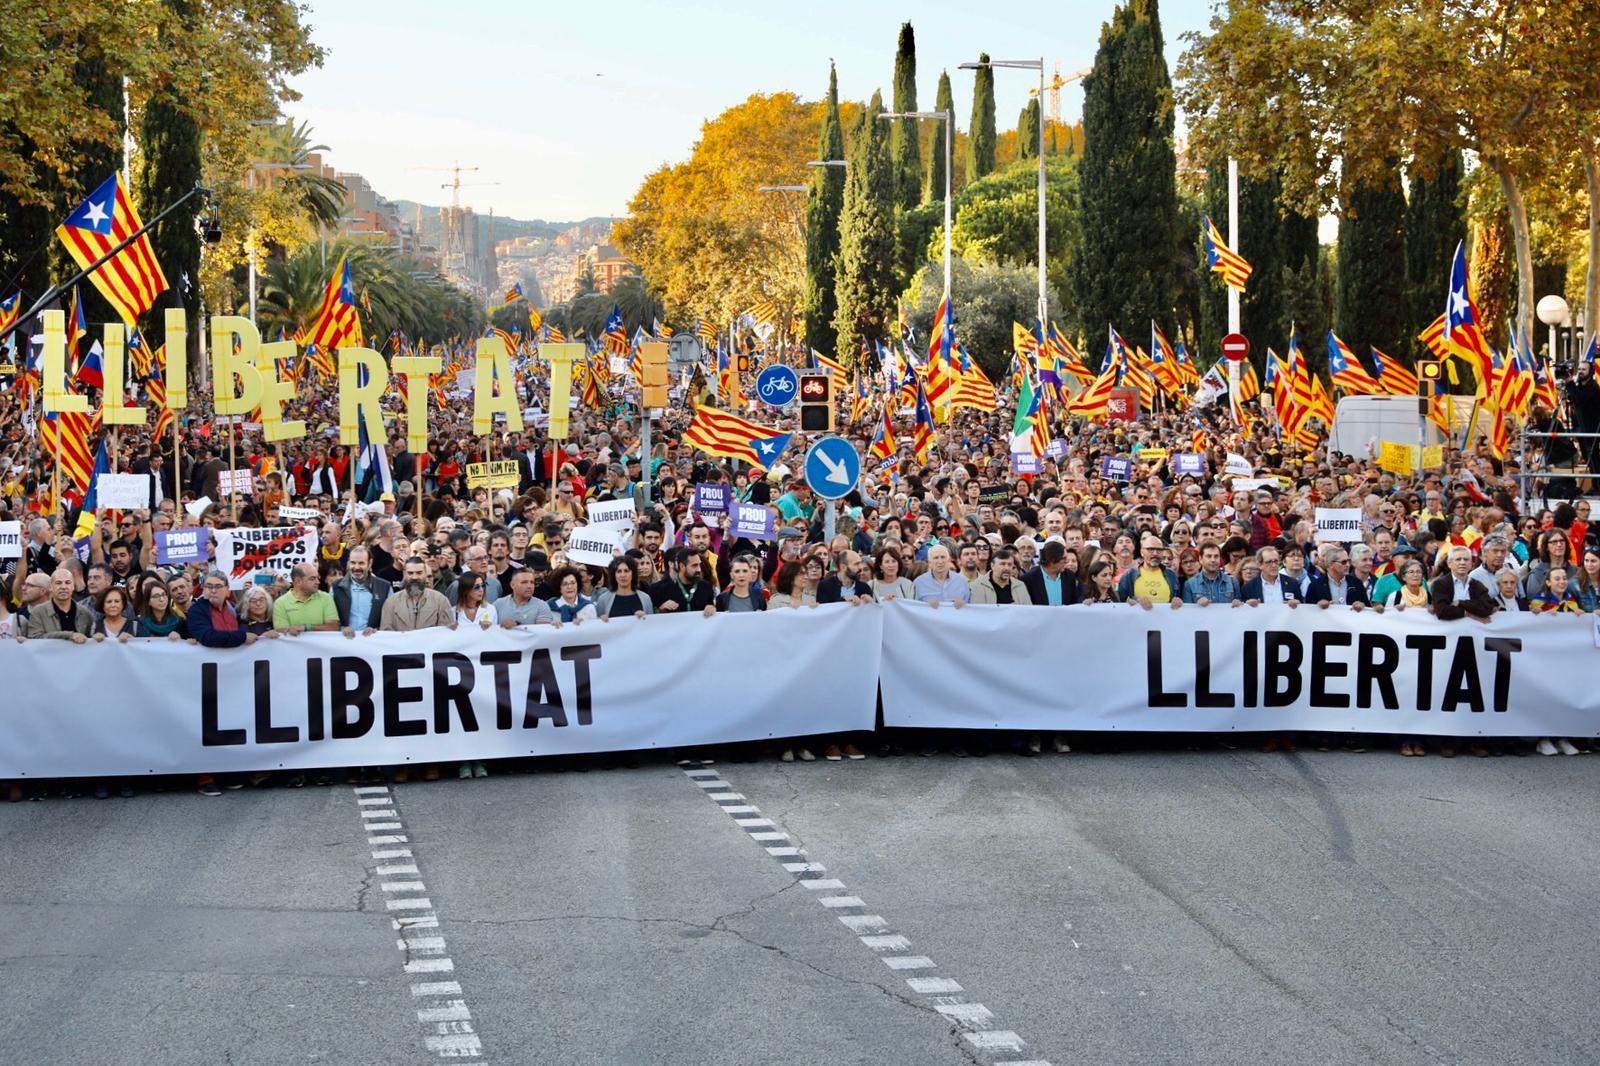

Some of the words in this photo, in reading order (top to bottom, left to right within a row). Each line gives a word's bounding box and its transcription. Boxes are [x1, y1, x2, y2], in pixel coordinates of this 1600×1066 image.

[700, 486, 724, 500] PROU
[592, 509, 632, 523] LLIBERTAT
[738, 507, 766, 523] PROU
[1317, 519, 1359, 530] LLIBERTAT
[166, 531, 197, 546] PROU
[571, 538, 613, 554] LLIBERTAT
[232, 541, 306, 556] PRESOS
[1146, 630, 1523, 713] LLIBERTAT
[201, 643, 602, 747] LLIBERTAT
